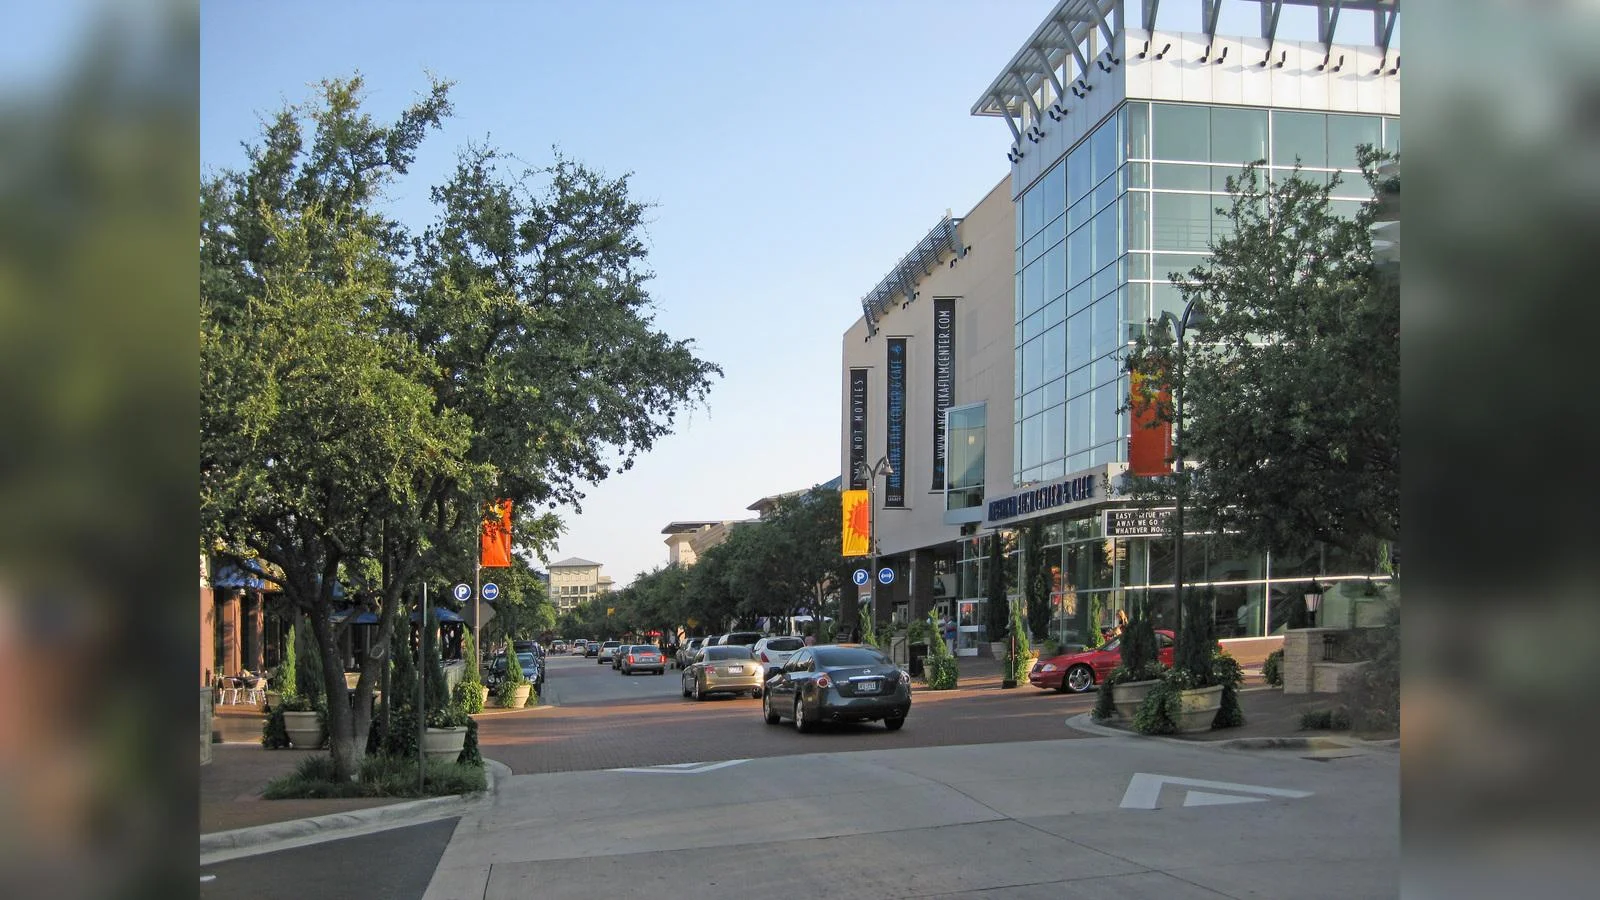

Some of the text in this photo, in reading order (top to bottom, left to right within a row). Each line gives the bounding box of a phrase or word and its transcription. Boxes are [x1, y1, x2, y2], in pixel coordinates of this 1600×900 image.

[937, 310, 950, 459] WWWANGELIKAFILMCENTER.COM
[854, 379, 864, 421] MOVIES
[854, 429, 863, 450] NOT
[1115, 526, 1147, 534] WHATEVER
[857, 572, 865, 583] P
[458, 586, 468, 598] P
